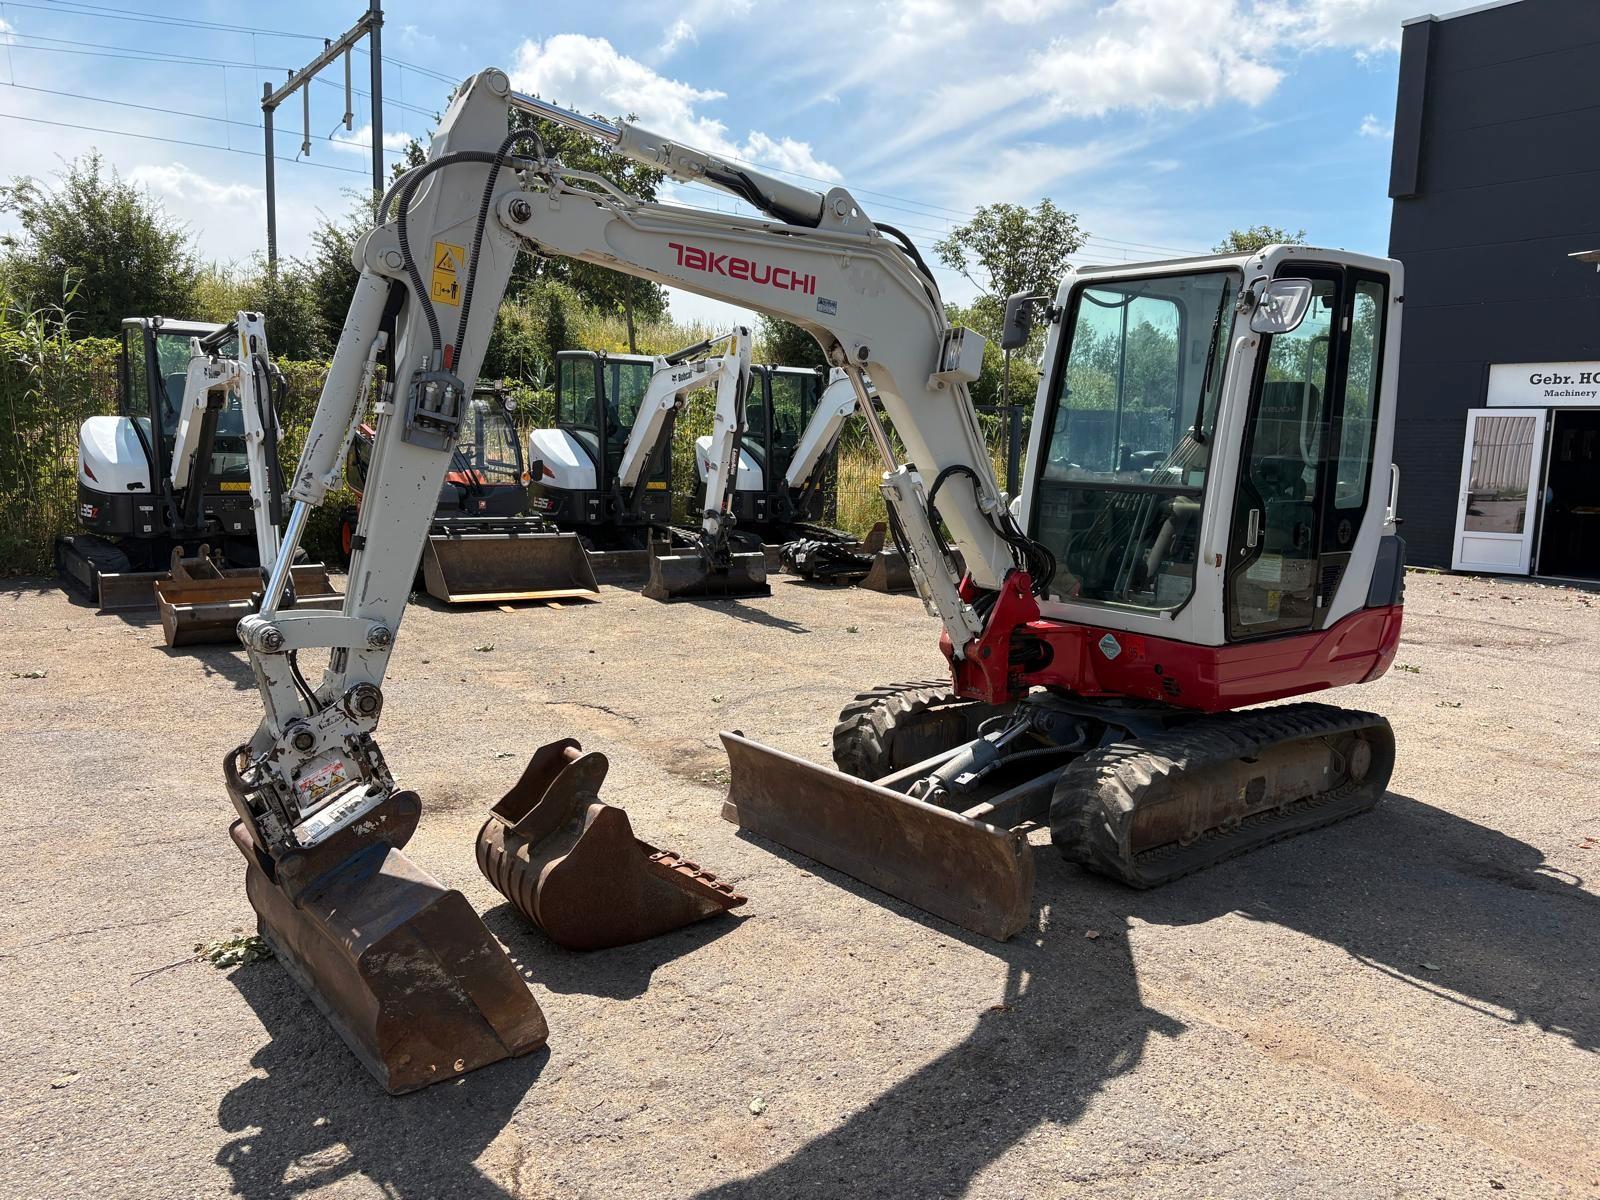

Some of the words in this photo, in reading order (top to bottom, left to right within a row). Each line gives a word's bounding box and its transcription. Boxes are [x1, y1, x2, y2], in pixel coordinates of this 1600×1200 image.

[669, 242, 816, 295] TAKEUCHI
[1529, 373, 1575, 385] Gebr.
[1544, 389, 1598, 398] Machinery
